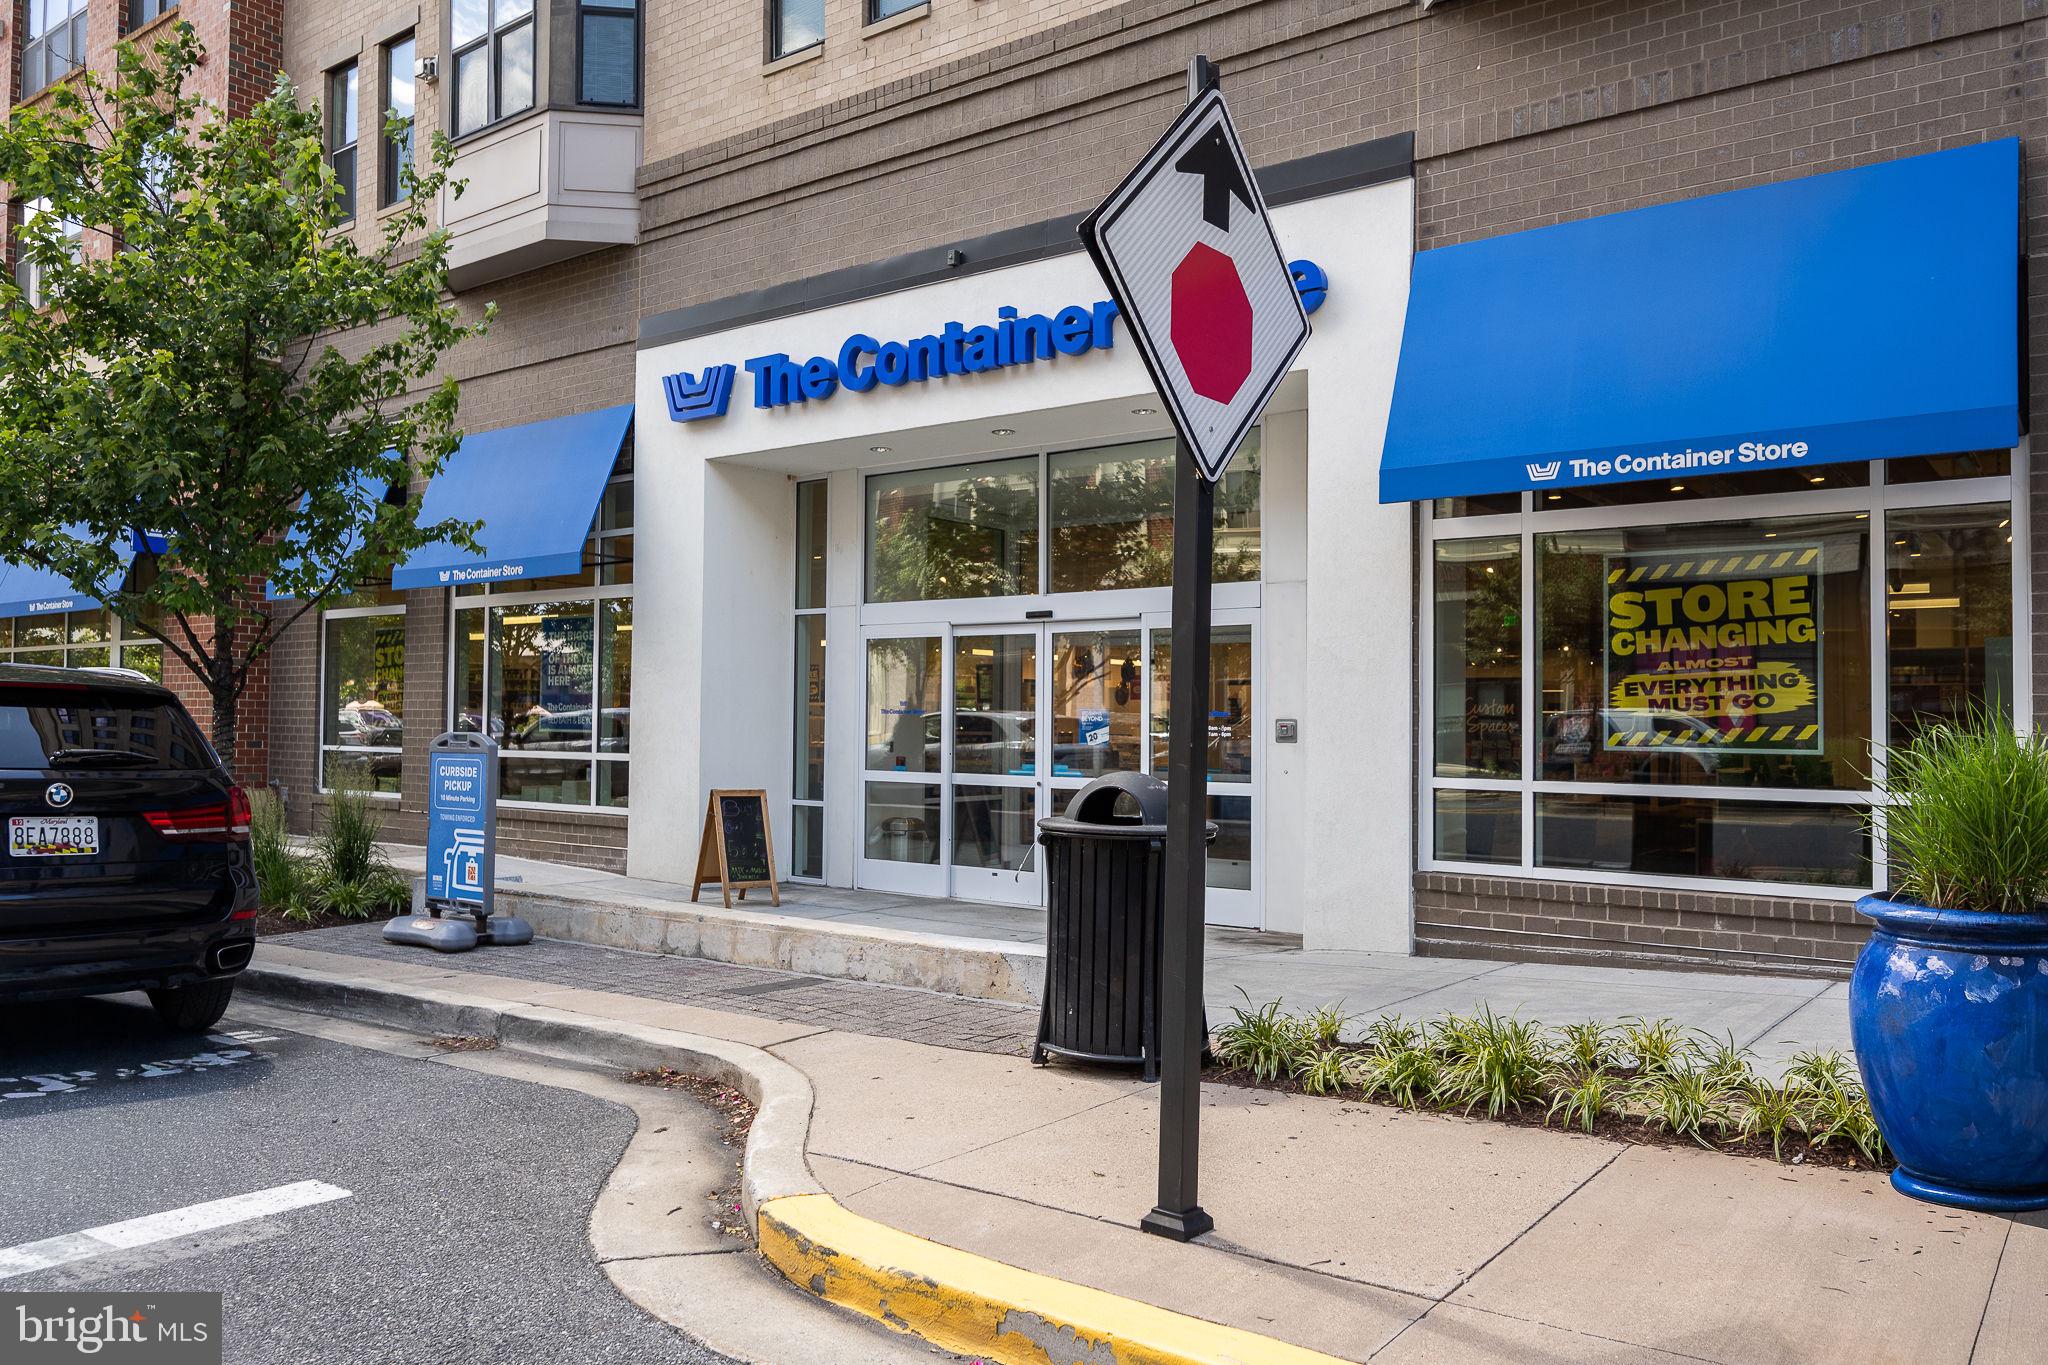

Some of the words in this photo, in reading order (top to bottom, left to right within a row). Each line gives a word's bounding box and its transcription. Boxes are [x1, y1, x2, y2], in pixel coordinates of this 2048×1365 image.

[745, 352, 839, 409] The
[838, 299, 1121, 392] Container
[1569, 459, 1611, 478] The
[1614, 448, 1735, 474] Container
[1737, 441, 1809, 462] Store
[452, 570, 466, 581] The
[466, 567, 502, 579] Container
[502, 565, 524, 577] Store
[1610, 575, 1811, 629] STORE
[568, 630, 594, 641] BIGGE
[1611, 617, 1817, 656] CHANGING
[376, 645, 404, 668] STO
[1657, 656, 1752, 672] ALMOST
[547, 675, 571, 687] HERE
[1624, 672, 1800, 697] EVERYTHING
[1465, 697, 1515, 716] Custom
[1647, 695, 1723, 713] MUST
[1732, 692, 1776, 709] GO
[1466, 715, 1516, 740] Spaces
[440, 766, 478, 778] CURBSIDE
[444, 780, 472, 792] PICKUP
[40, 818, 68, 826] Maryland
[15, 827, 94, 845] 8EA7888
